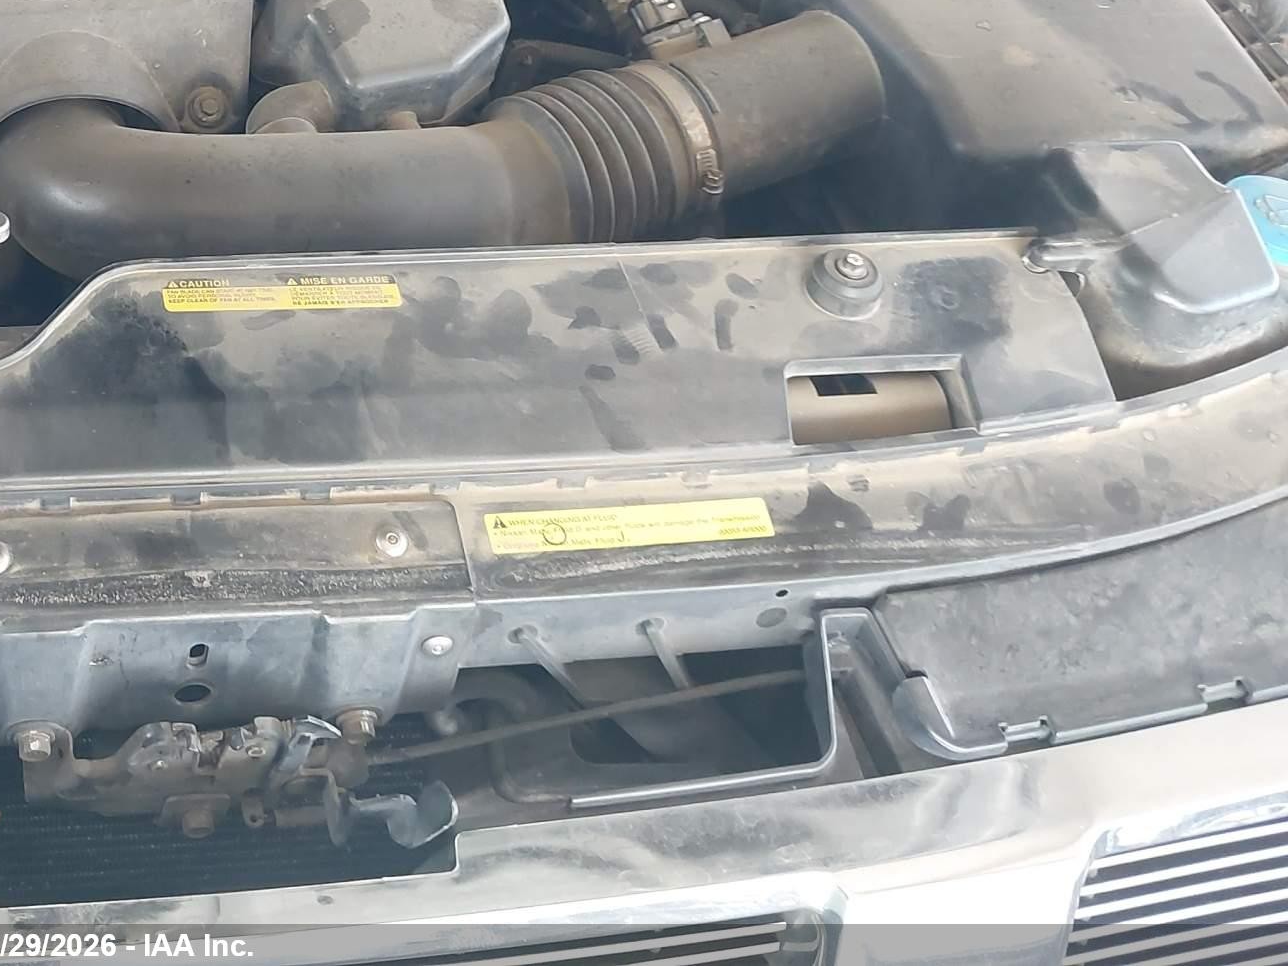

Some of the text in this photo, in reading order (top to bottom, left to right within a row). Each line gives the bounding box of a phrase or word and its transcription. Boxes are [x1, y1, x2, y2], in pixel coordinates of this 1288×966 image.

[179, 279, 230, 288] CAUTION
[299, 277, 328, 285] MISE
[348, 275, 390, 284] GARDE
